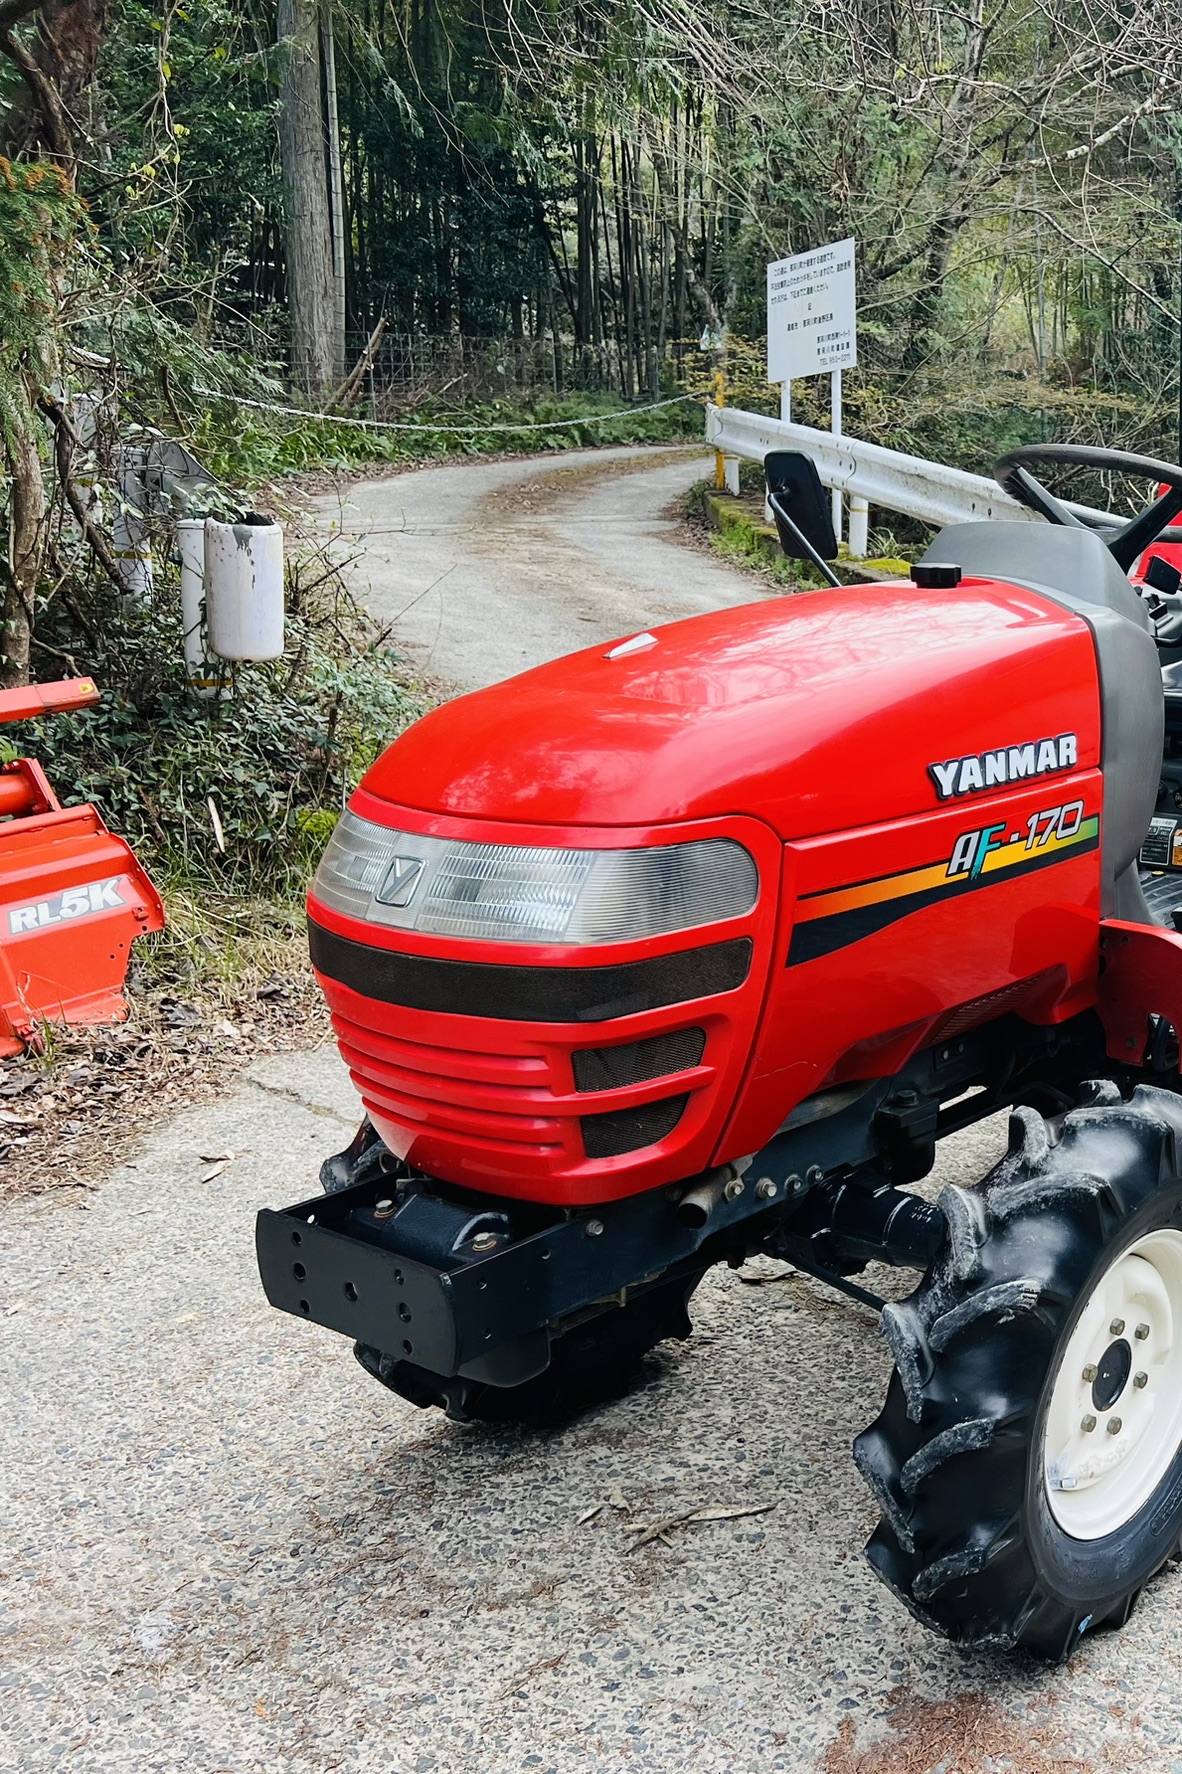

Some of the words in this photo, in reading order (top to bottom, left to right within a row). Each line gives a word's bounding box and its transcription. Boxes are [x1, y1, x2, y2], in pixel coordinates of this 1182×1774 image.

[930, 733, 1077, 797] YANMAR
[947, 800, 1084, 879] AF-170
[9, 877, 124, 935] RL5K
